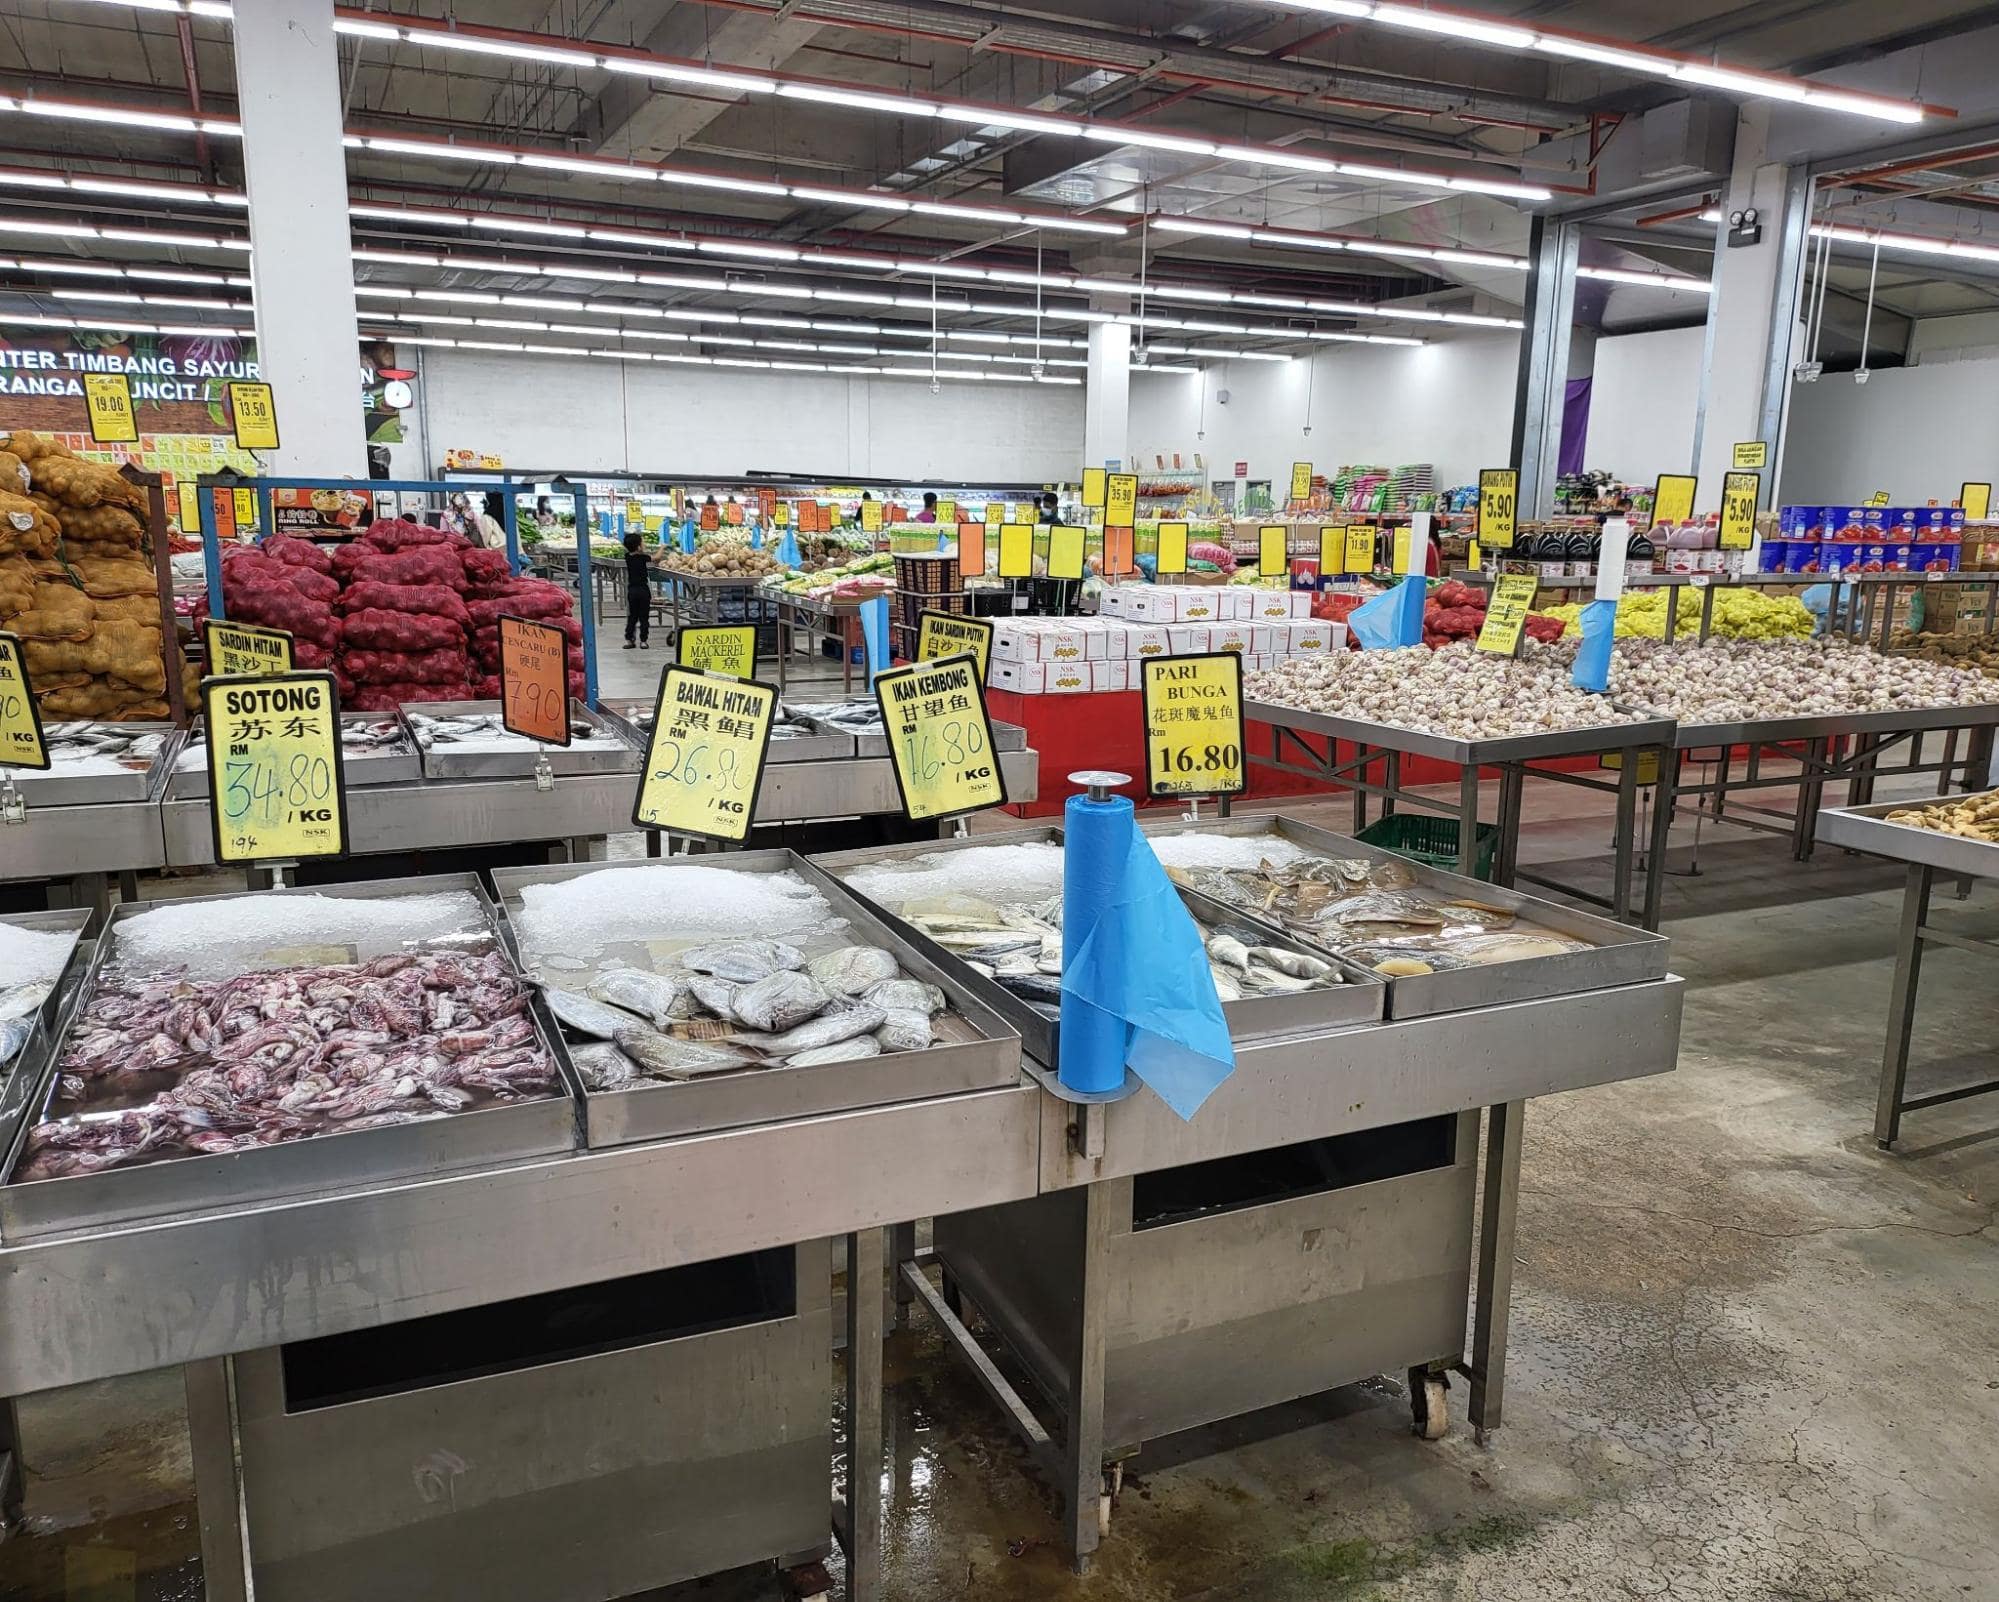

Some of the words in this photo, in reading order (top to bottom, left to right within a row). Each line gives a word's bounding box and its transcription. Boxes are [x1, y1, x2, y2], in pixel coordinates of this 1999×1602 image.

[63, 353, 176, 375] TIMBANG
[184, 358, 260, 379] SAYUR
[95, 396, 124, 412] 19.00
[240, 402, 266, 416] 13.50
[1487, 494, 1512, 518] 5.90
[1729, 497, 1753, 521] 5.90
[1495, 524, 1511, 532] /KG
[1736, 526, 1750, 534] /KG
[518, 623, 546, 639] IKAN
[695, 633, 742, 645] SARDIN
[930, 620, 945, 635] IKAN
[945, 622, 966, 640] SARDIN
[966, 626, 984, 643] PUTIH
[219, 631, 251, 653] SARDIN
[253, 637, 283, 658] HITAM
[689, 644, 746, 657] MACKEREL
[927, 649, 938, 659] RM
[1155, 665, 1198, 681] PARI
[892, 680, 919, 702] IKAN
[918, 668, 968, 696] KEMBONG
[1167, 685, 1227, 700] BUNGA
[226, 686, 321, 715] SOTONG
[506, 680, 561, 722] 7.90
[676, 681, 719, 709] BAWAL
[721, 690, 763, 718] HITAM
[899, 694, 972, 723] 甘望鱼
[1152, 704, 1235, 723] 花斑魔鬼鱼
[229, 716, 321, 742] 苏东
[669, 727, 687, 740] RM
[902, 725, 917, 735] RM
[1148, 727, 1166, 737] Rm
[230, 744, 249, 756] RM
[907, 721, 983, 786] 16.80
[1160, 744, 1239, 773] 16.80
[224, 753, 330, 819] 34.80
[305, 828, 328, 837] NSK
